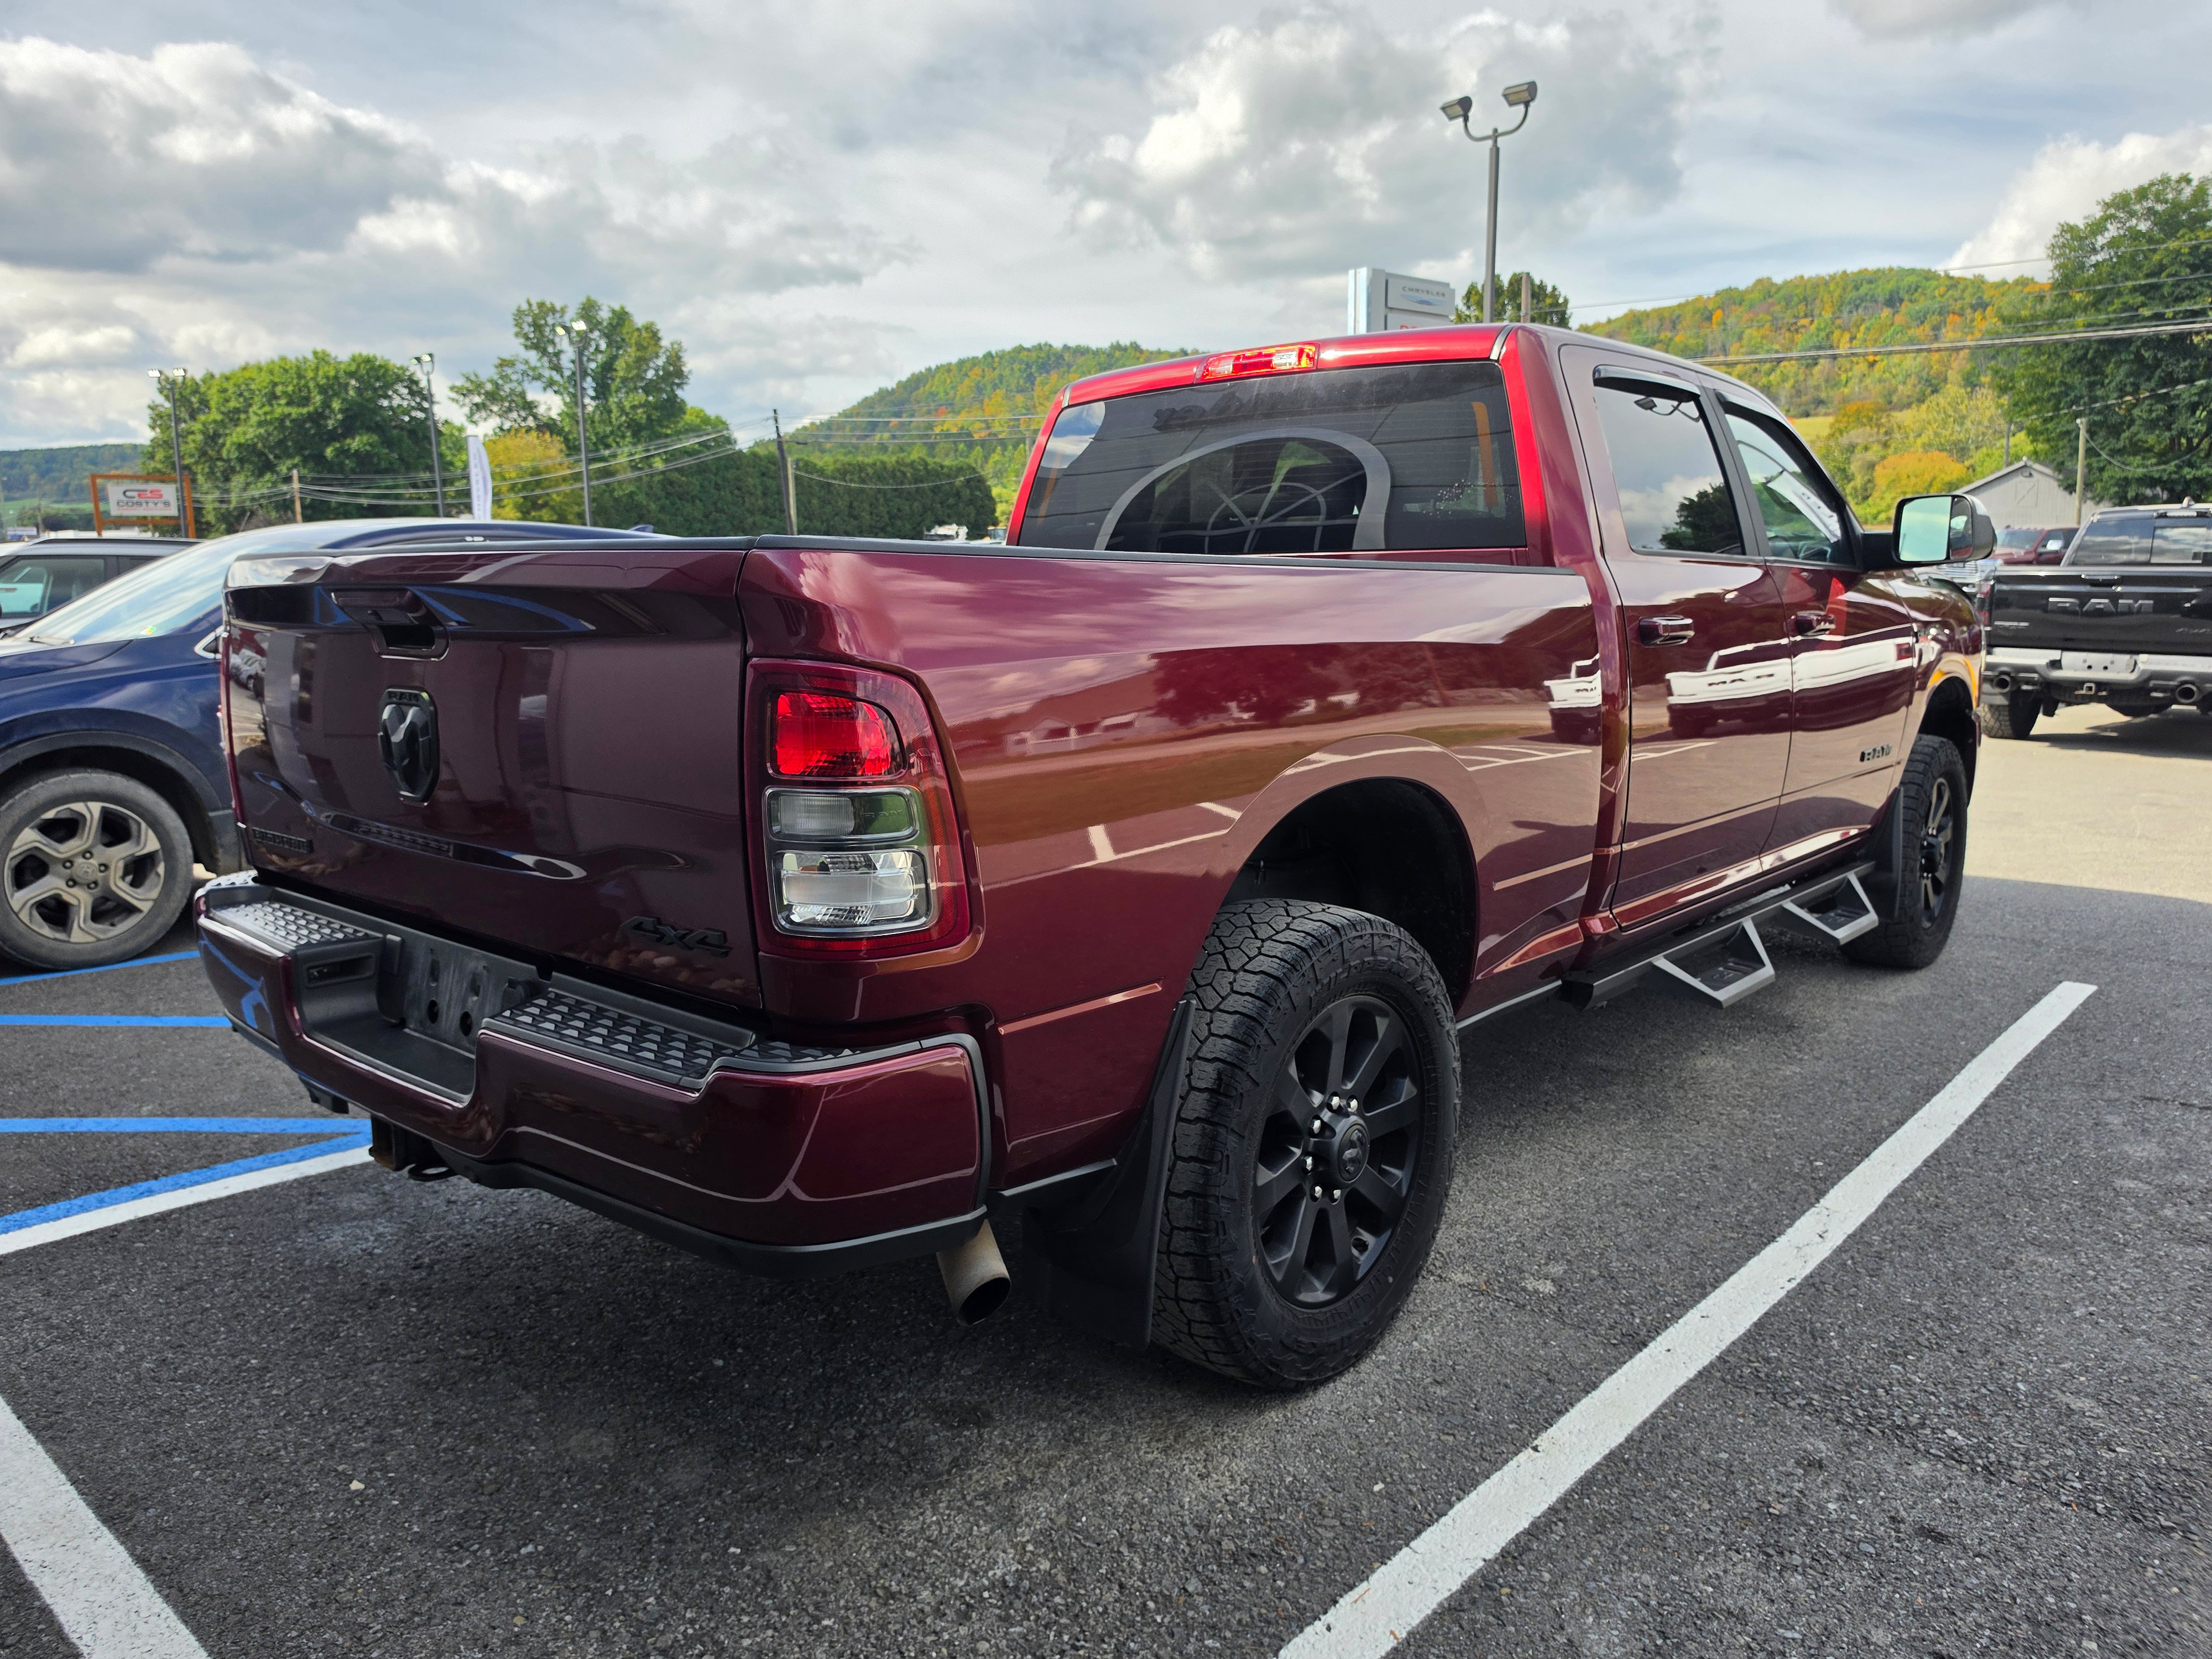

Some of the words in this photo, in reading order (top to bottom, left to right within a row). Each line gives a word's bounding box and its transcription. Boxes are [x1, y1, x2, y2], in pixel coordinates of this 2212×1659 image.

[1402, 286, 1446, 298] CHRYSLER
[123, 488, 164, 499] CES
[116, 499, 171, 508] COSTY'S
[2048, 597, 2154, 615] RAM
[388, 691, 420, 702] RAM
[1860, 743, 1892, 763] RAM
